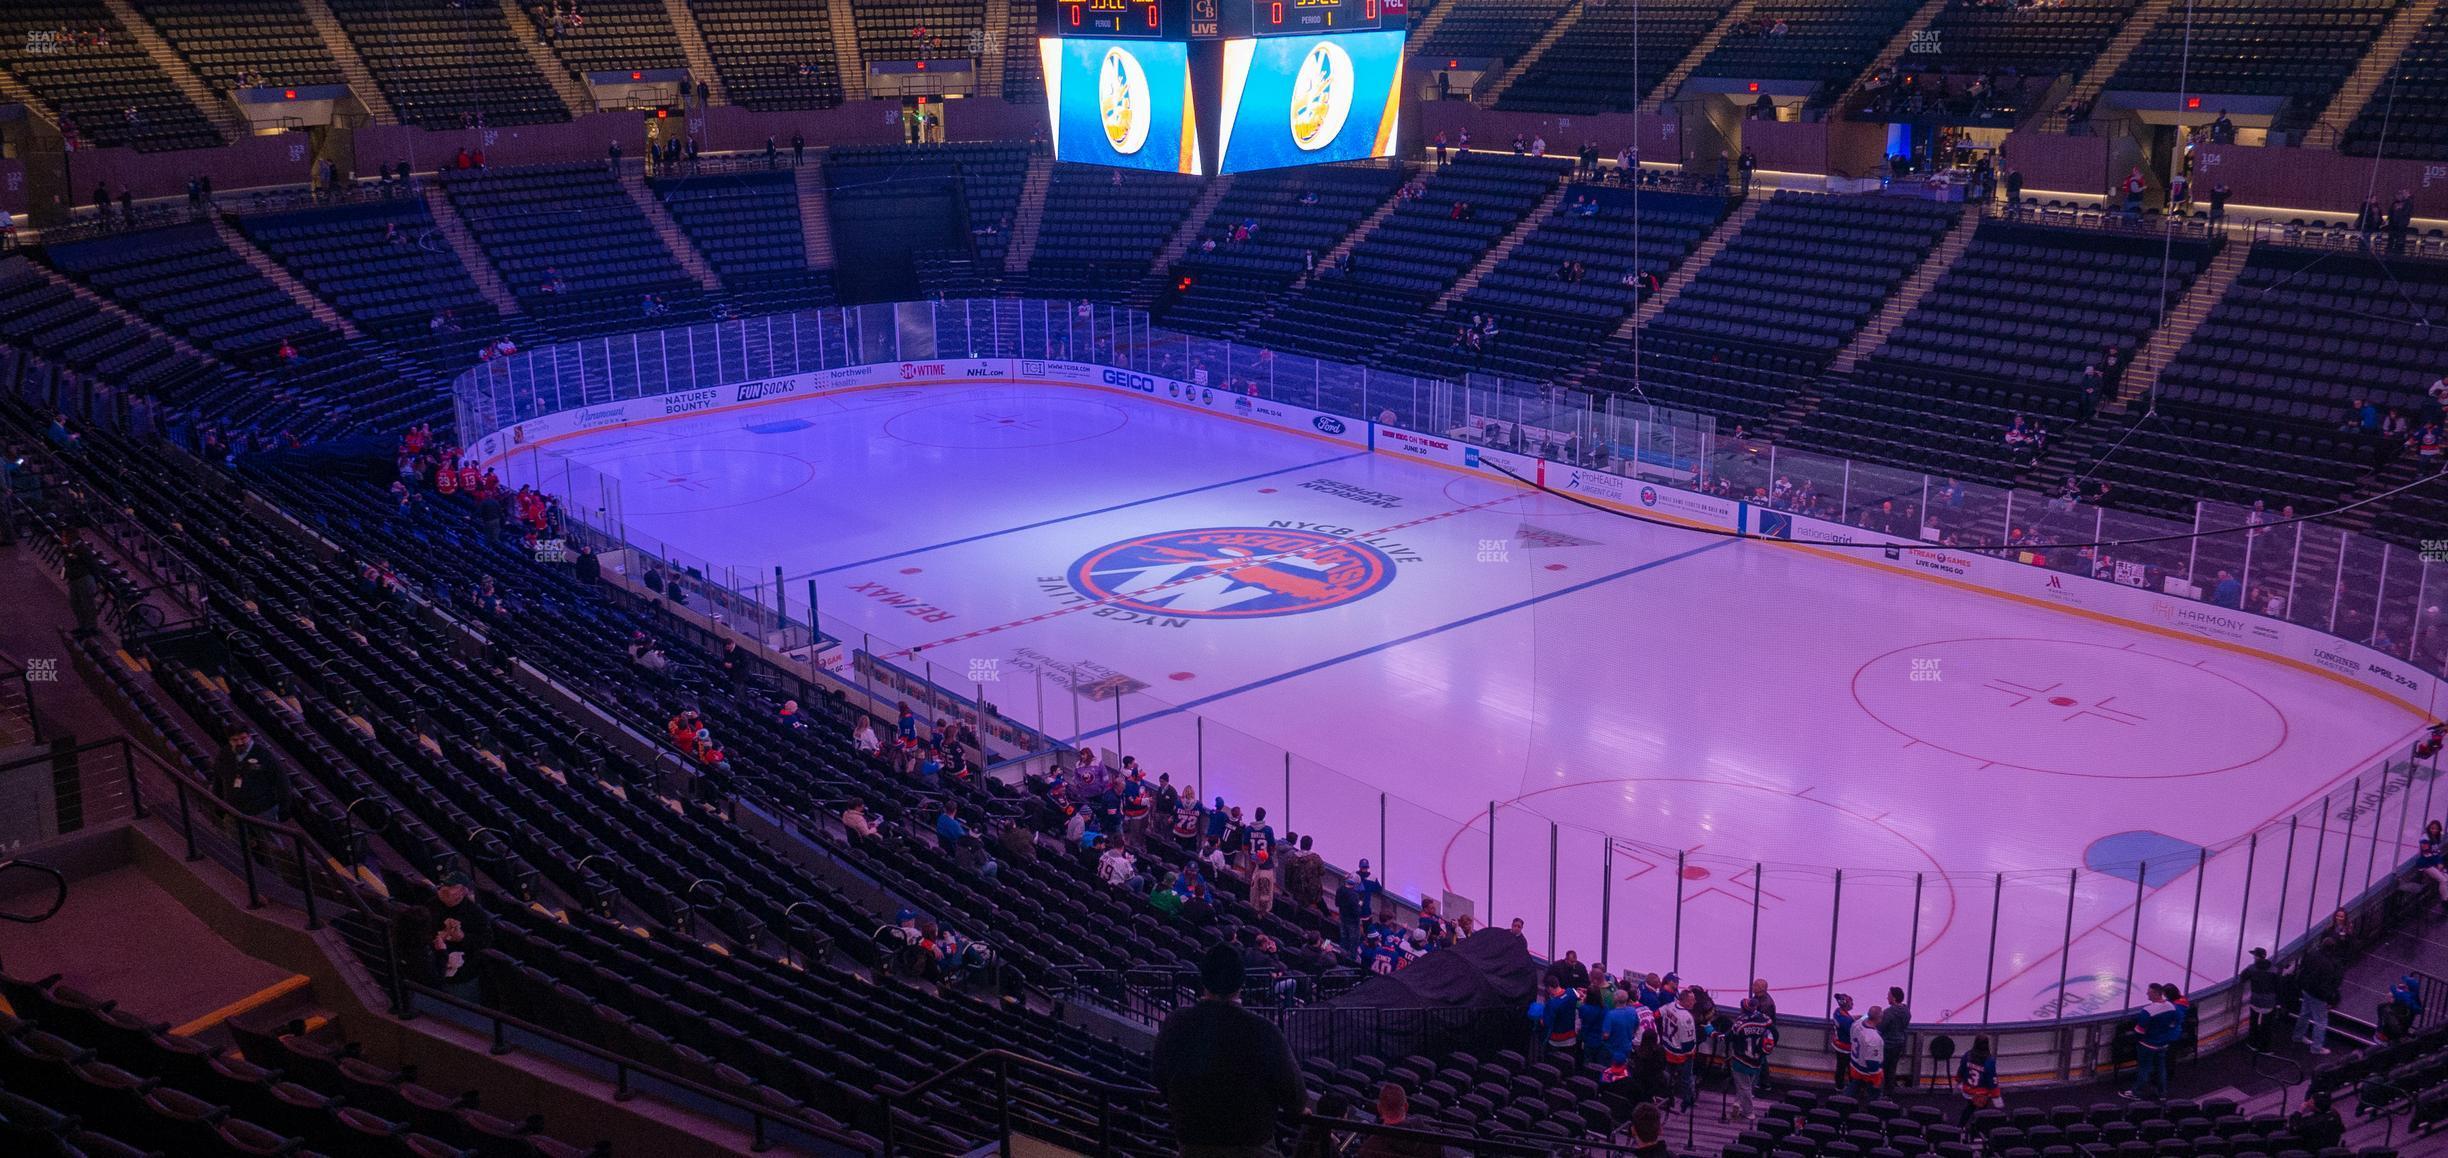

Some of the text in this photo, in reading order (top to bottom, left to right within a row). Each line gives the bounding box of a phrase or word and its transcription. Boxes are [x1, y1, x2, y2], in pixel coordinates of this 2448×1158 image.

[1095, 20, 1111, 28] PERIOD
[1301, 16, 1321, 24] PERIOD
[1192, 23, 1217, 34] LIVE
[2202, 153, 2220, 163] 104
[2424, 165, 2446, 177] 105
[831, 366, 872, 379] Northwell
[900, 364, 945, 379] SHOWTIME
[1103, 369, 1154, 393] GEICO
[665, 390, 717, 405] NATURE'S
[739, 379, 796, 401] FUN SOCKS
[666, 400, 710, 414] BOUNTY
[573, 407, 625, 426] Paramount
[1317, 416, 1342, 434] Ford
[1409, 435, 1418, 443] ON
[1404, 445, 1418, 453] JUNE
[465, 475, 476, 486] 13
[1297, 482, 1403, 508] AMERICAN
[1311, 479, 1403, 502] EXPRESS
[1581, 485, 1622, 500] URGENT CARE
[1268, 520, 1423, 563] NYCB LIVE
[1797, 527, 1852, 544] nationalgrid
[1940, 565, 1953, 573] MSG
[846, 582, 956, 623] RE/MAX
[1037, 576, 1190, 628] NYCB LIVE
[2178, 610, 2245, 631] HARMONY
[2314, 648, 2360, 671] LONGINES
[2368, 664, 2417, 690] APRIL 25-28
[1177, 815, 1198, 830] 72
[1967, 1069, 1980, 1086] 3
